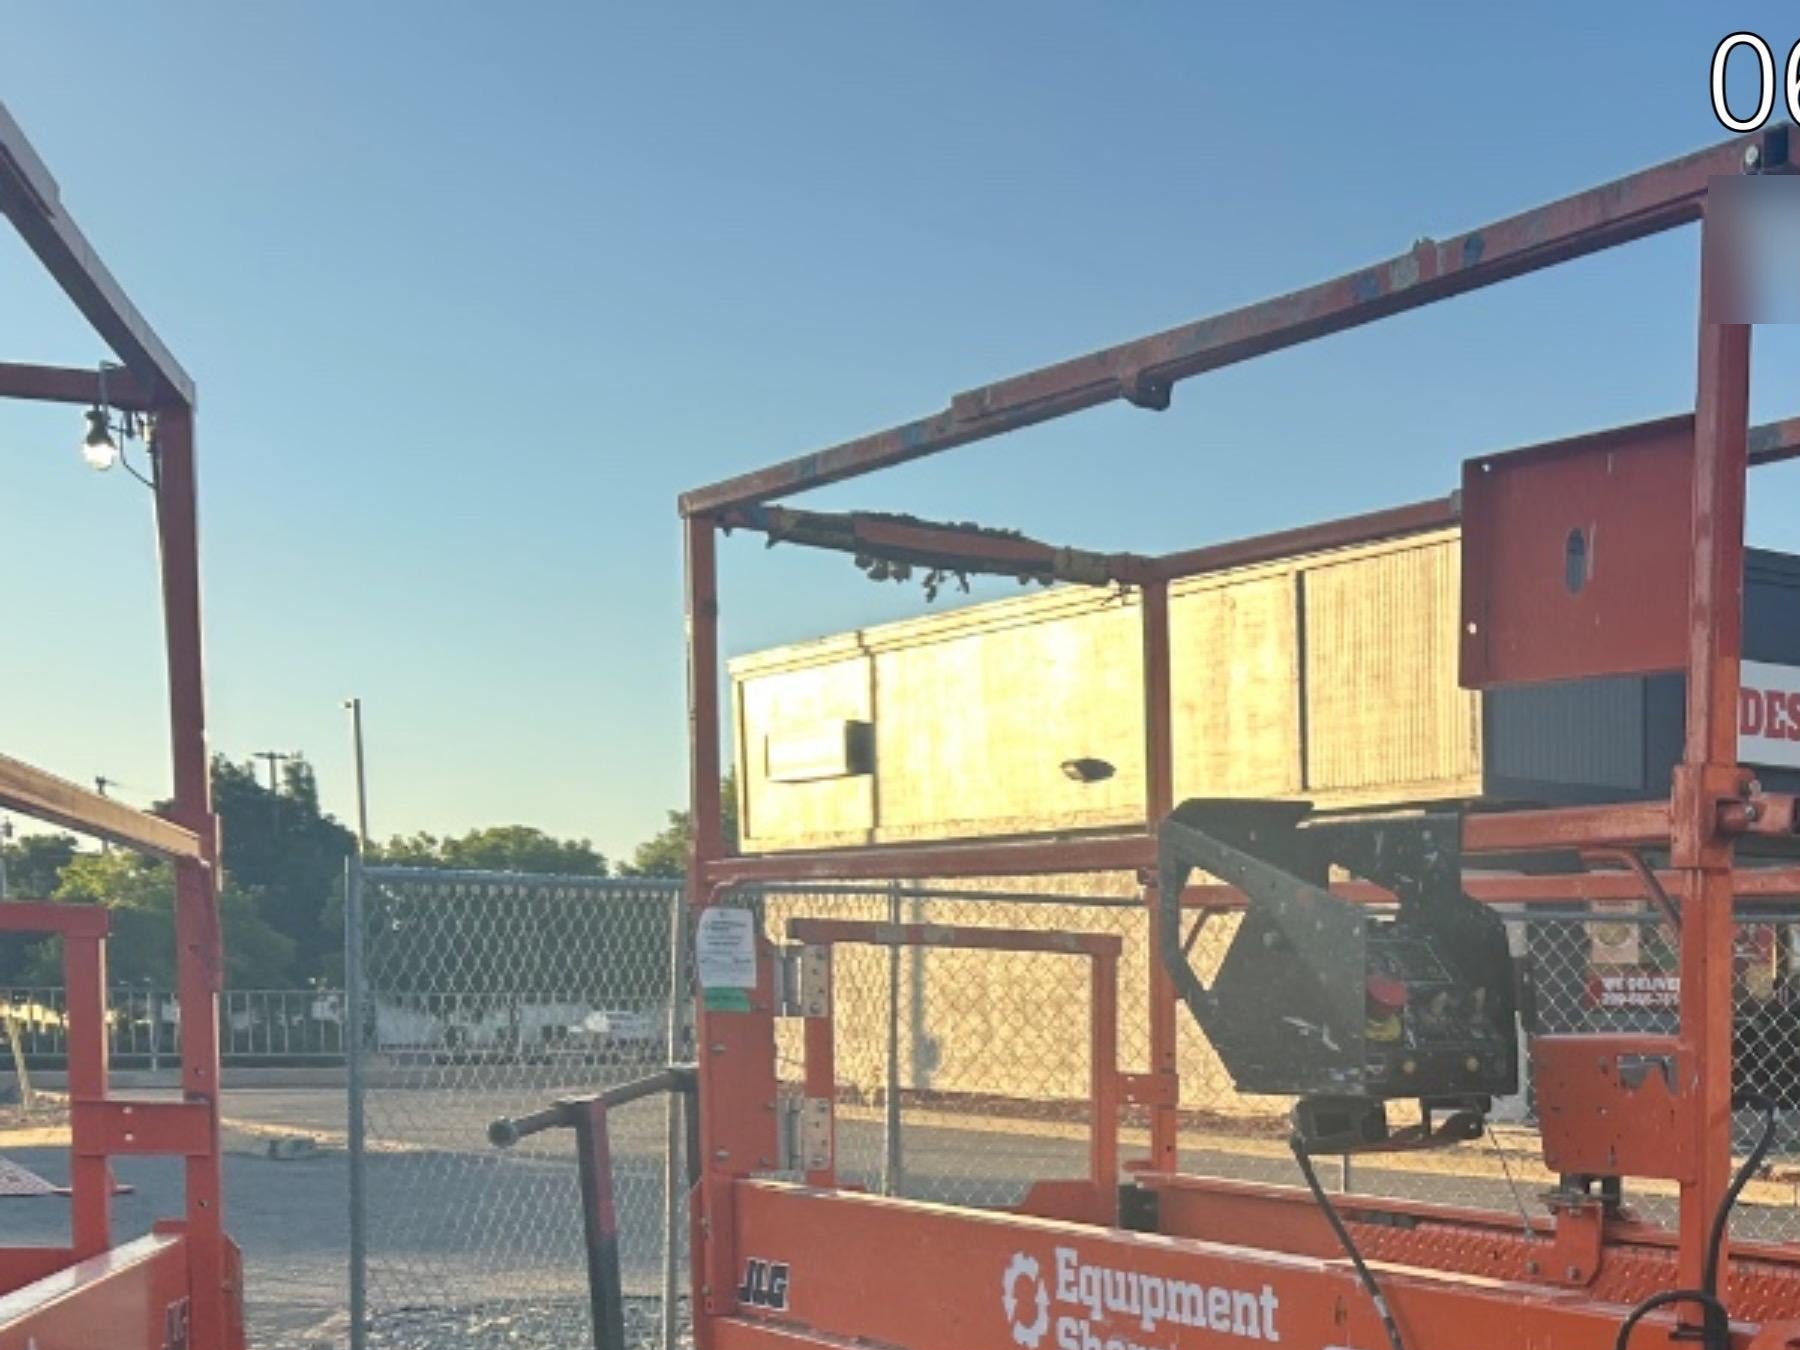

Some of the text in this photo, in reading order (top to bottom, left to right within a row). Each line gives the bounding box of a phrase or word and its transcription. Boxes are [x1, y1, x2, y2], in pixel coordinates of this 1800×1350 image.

[1628, 976, 1681, 991] DELIVE
[737, 1257, 790, 1312] JLG
[1055, 1247, 1280, 1342] Equipment
